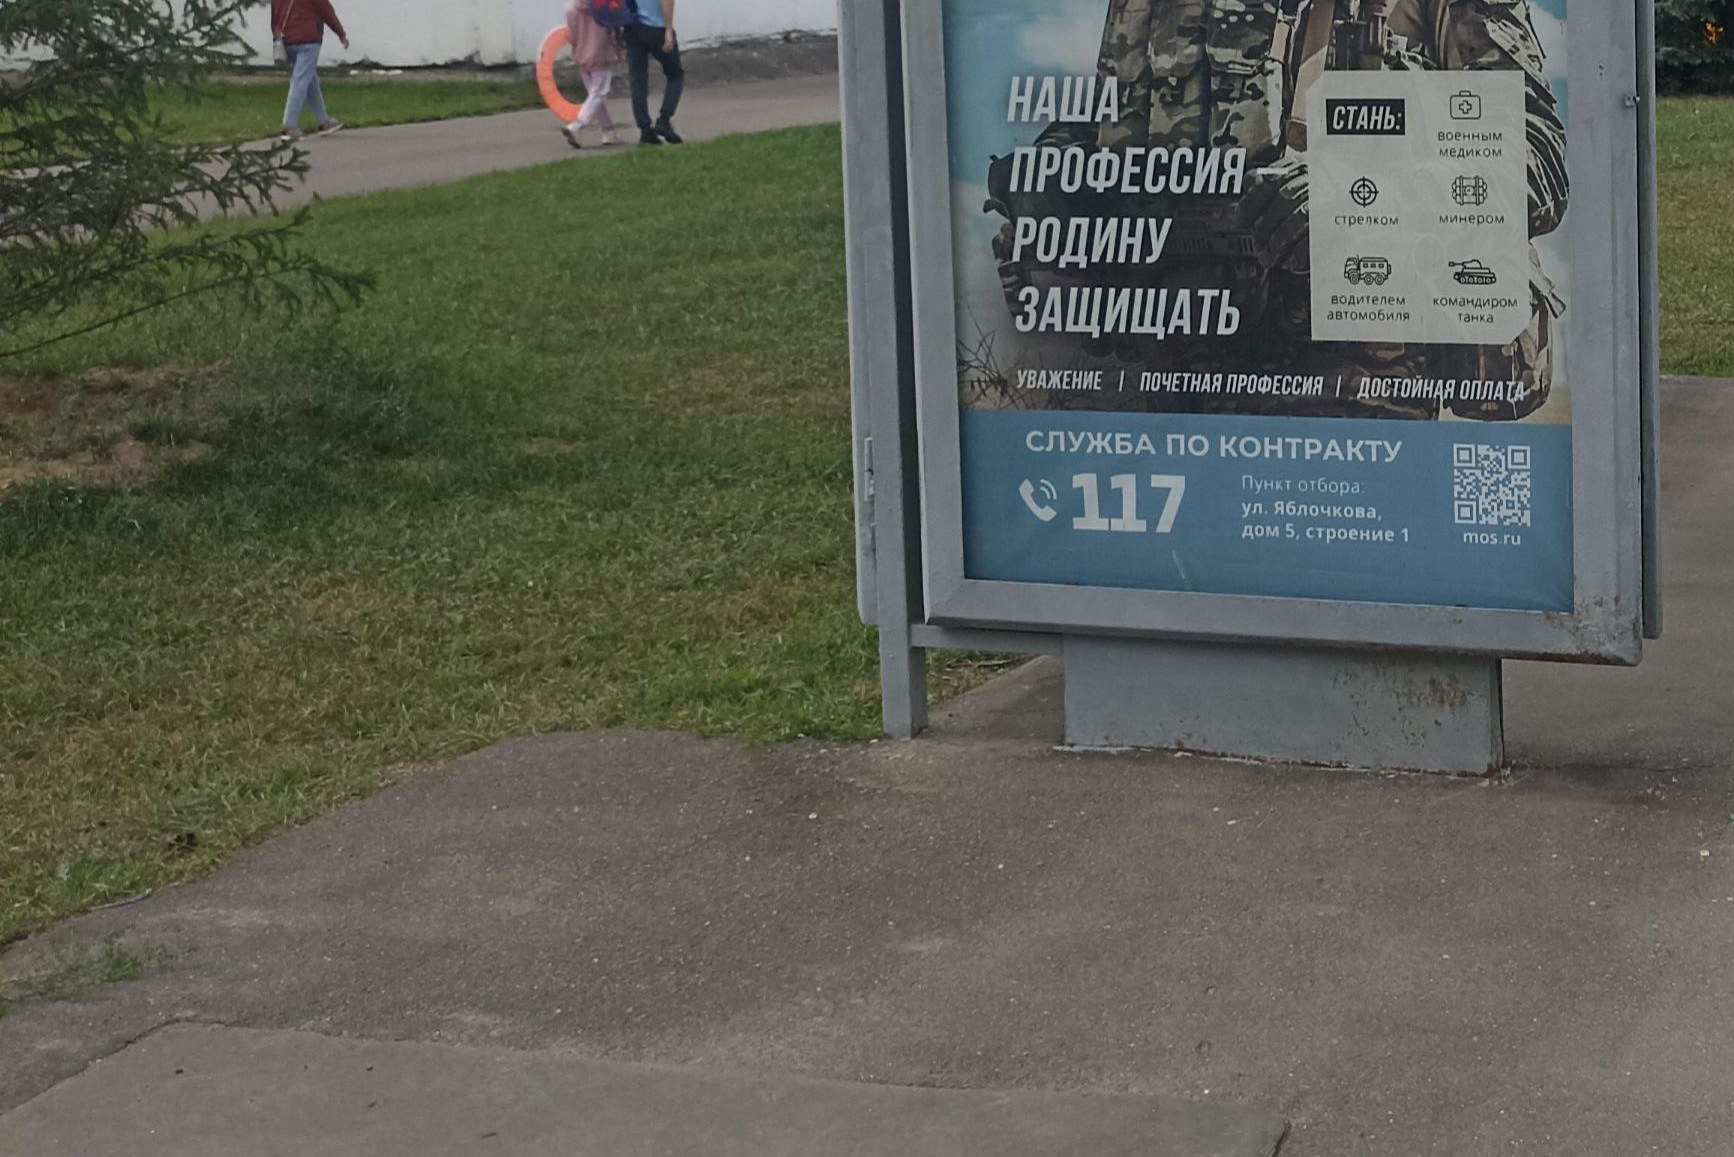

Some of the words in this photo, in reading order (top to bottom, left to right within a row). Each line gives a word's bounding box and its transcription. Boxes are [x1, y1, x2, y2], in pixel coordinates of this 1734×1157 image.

[1007, 75, 1119, 123] НАША
[1332, 105, 1402, 131] СТАНЬ:
[1437, 130, 1503, 142] военным
[1439, 146, 1502, 158] медиком
[1009, 146, 1247, 195] ПРОФЕССИЯ
[1334, 215, 1399, 227] стрелком
[1439, 214, 1505, 226] минером
[1012, 216, 1172, 269] РОДИНУ
[1331, 295, 1406, 307] водителем
[1433, 296, 1518, 309] командиром
[1015, 285, 1241, 341] ЗАЩИЩАТЬ
[1327, 310, 1410, 322] автомобиля
[1458, 313, 1494, 324] танка
[1017, 369, 1103, 390] УВАЖЕНИЕ
[1140, 372, 1222, 393] ПОЧЕТНАЯ
[1226, 374, 1324, 396] ПРОФЕССИЯ
[1357, 375, 1456, 400] ДОСТОЙНАЯ
[1459, 379, 1527, 402] ОПЛАТА
[1025, 430, 1156, 455] СЛУЖБА
[1166, 434, 1209, 457] ПО
[1219, 435, 1402, 463] КОНТРАКТУ
[1242, 474, 1291, 494] Пункт
[1298, 477, 1365, 497] отбора:
[1072, 472, 1186, 534] 117
[1242, 502, 1268, 518] ул.
[1274, 500, 1382, 521] Яблочкова,
[1242, 525, 1280, 540] дом
[1285, 523, 1301, 541] 5,
[1305, 526, 1395, 543] строение
[1401, 528, 1409, 542] 1
[1463, 529, 1521, 545] mos.ru
